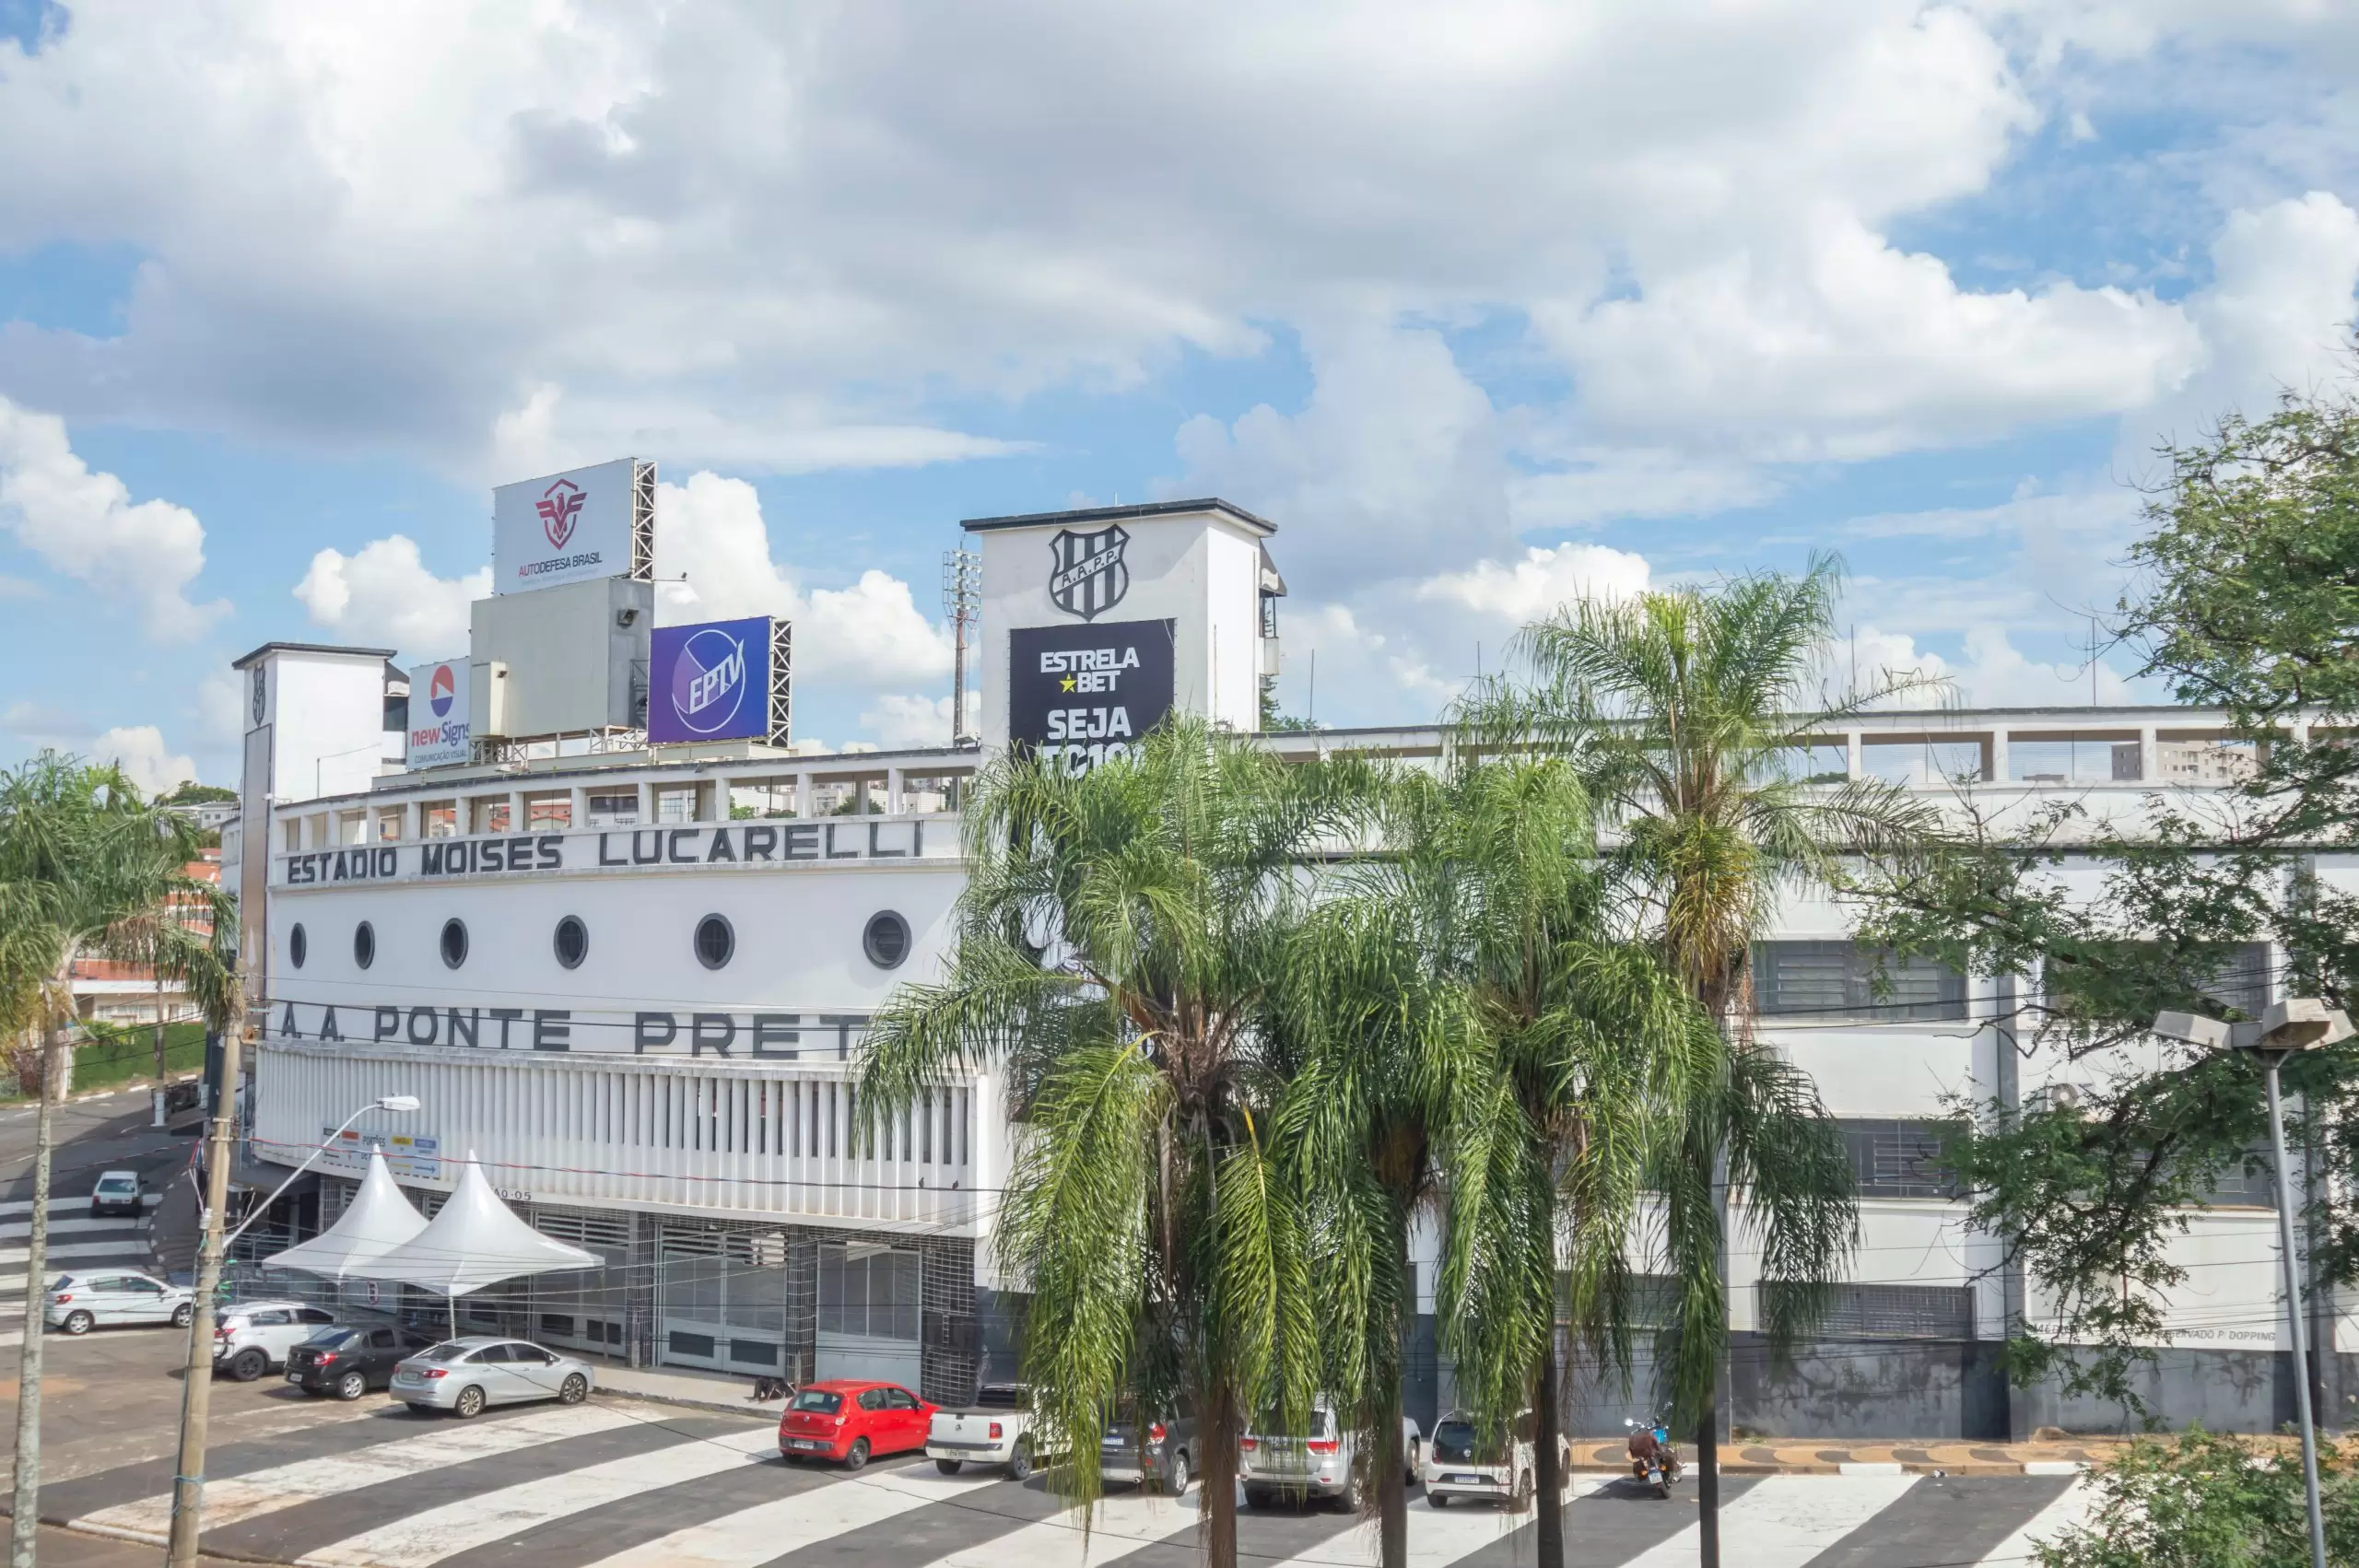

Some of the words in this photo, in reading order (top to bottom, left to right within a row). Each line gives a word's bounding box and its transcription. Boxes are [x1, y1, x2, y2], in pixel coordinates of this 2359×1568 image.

[518, 556, 571, 578] AUTODEFESA
[572, 551, 603, 568] BRASIL
[1062, 550, 1118, 587] A.A.P.P.
[689, 638, 745, 715] EPTV
[1040, 647, 1141, 673] ESTRELA
[1077, 670, 1121, 693] BET
[1047, 707, 1133, 740] SEJA
[288, 847, 397, 884] ESTADIO
[421, 835, 564, 876] MOISES
[599, 820, 923, 867] LUCARELLI
[374, 1006, 570, 1052] PONTE
[634, 1012, 871, 1061] PRET
[2229, 1330, 2276, 1341] DOPPING
